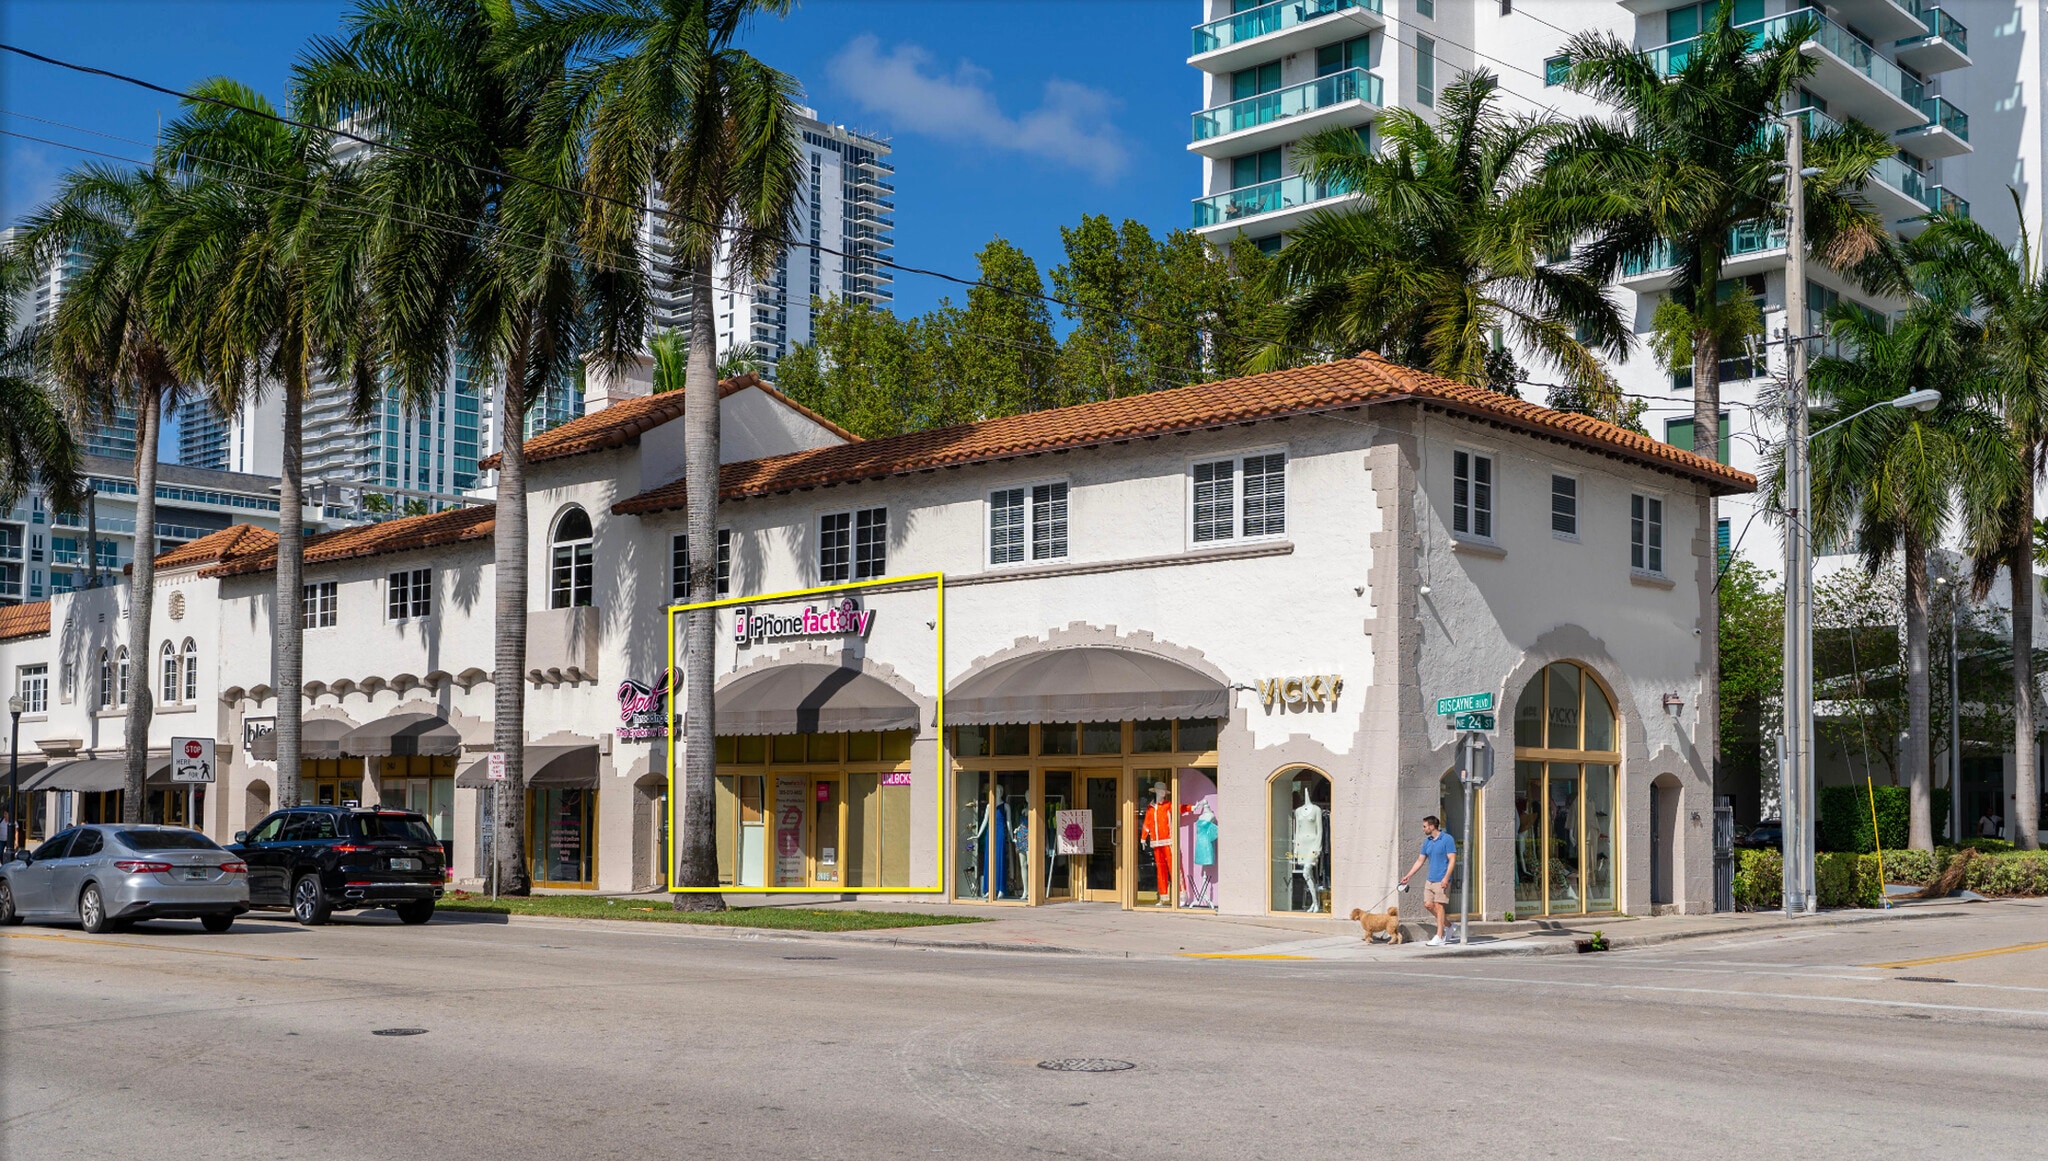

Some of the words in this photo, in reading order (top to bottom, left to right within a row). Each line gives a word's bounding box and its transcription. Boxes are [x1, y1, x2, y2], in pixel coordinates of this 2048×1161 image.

[1254, 674, 1341, 705] VICKY
[1440, 696, 1474, 713] BISCAYNE
[1475, 698, 1488, 709] BLVD
[1456, 719, 1466, 728] NE
[1468, 715, 1482, 729] 24
[1485, 718, 1493, 728] ST
[185, 745, 202, 754] STOP
